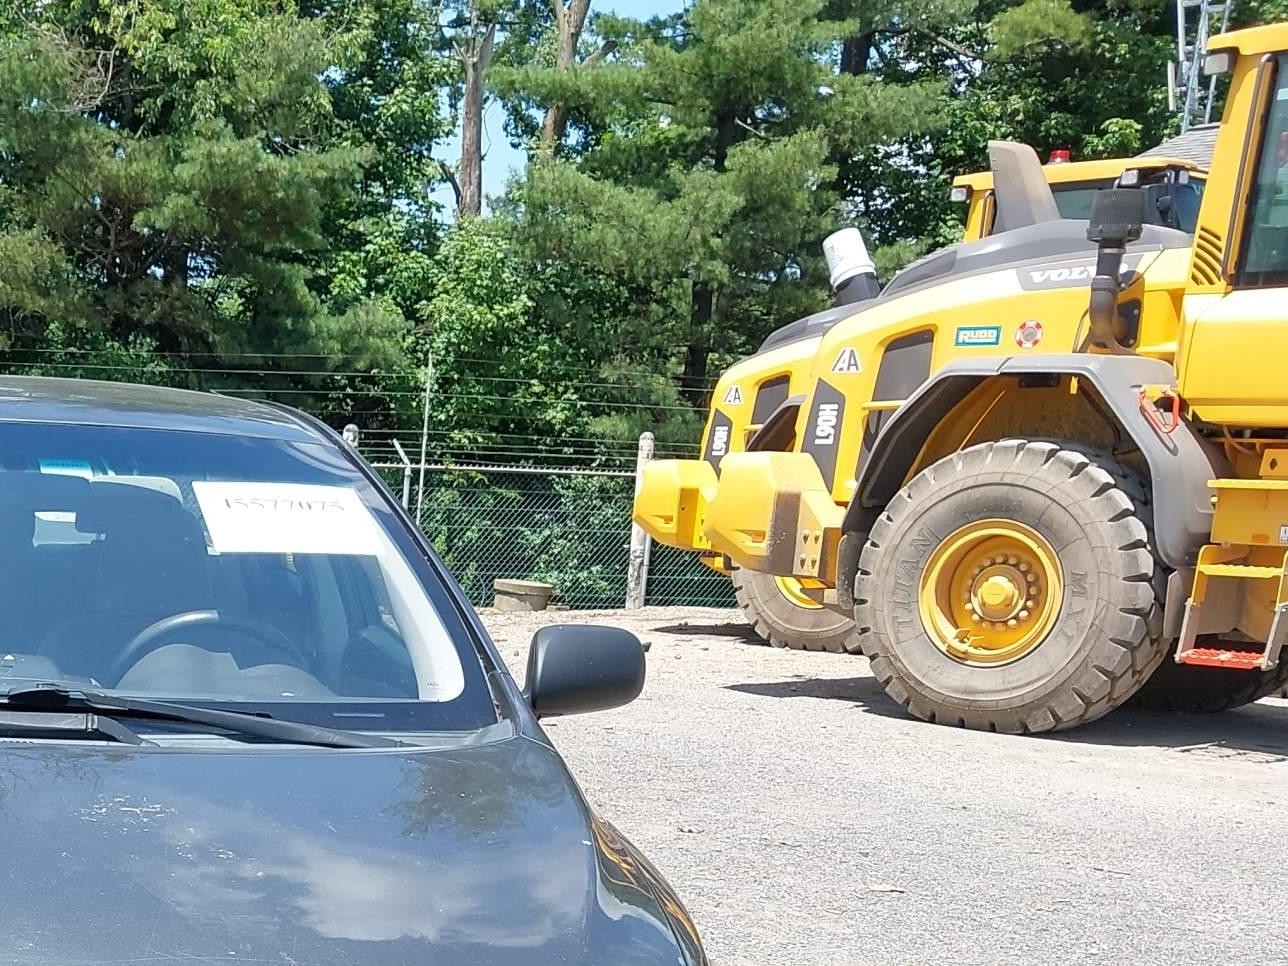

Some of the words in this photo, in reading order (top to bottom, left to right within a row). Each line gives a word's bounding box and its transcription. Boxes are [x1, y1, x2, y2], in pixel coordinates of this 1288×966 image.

[959, 329, 997, 343] RUDD
[712, 426, 729, 456] L90H
[815, 403, 838, 445] L90H
[893, 528, 939, 632] TITAN
